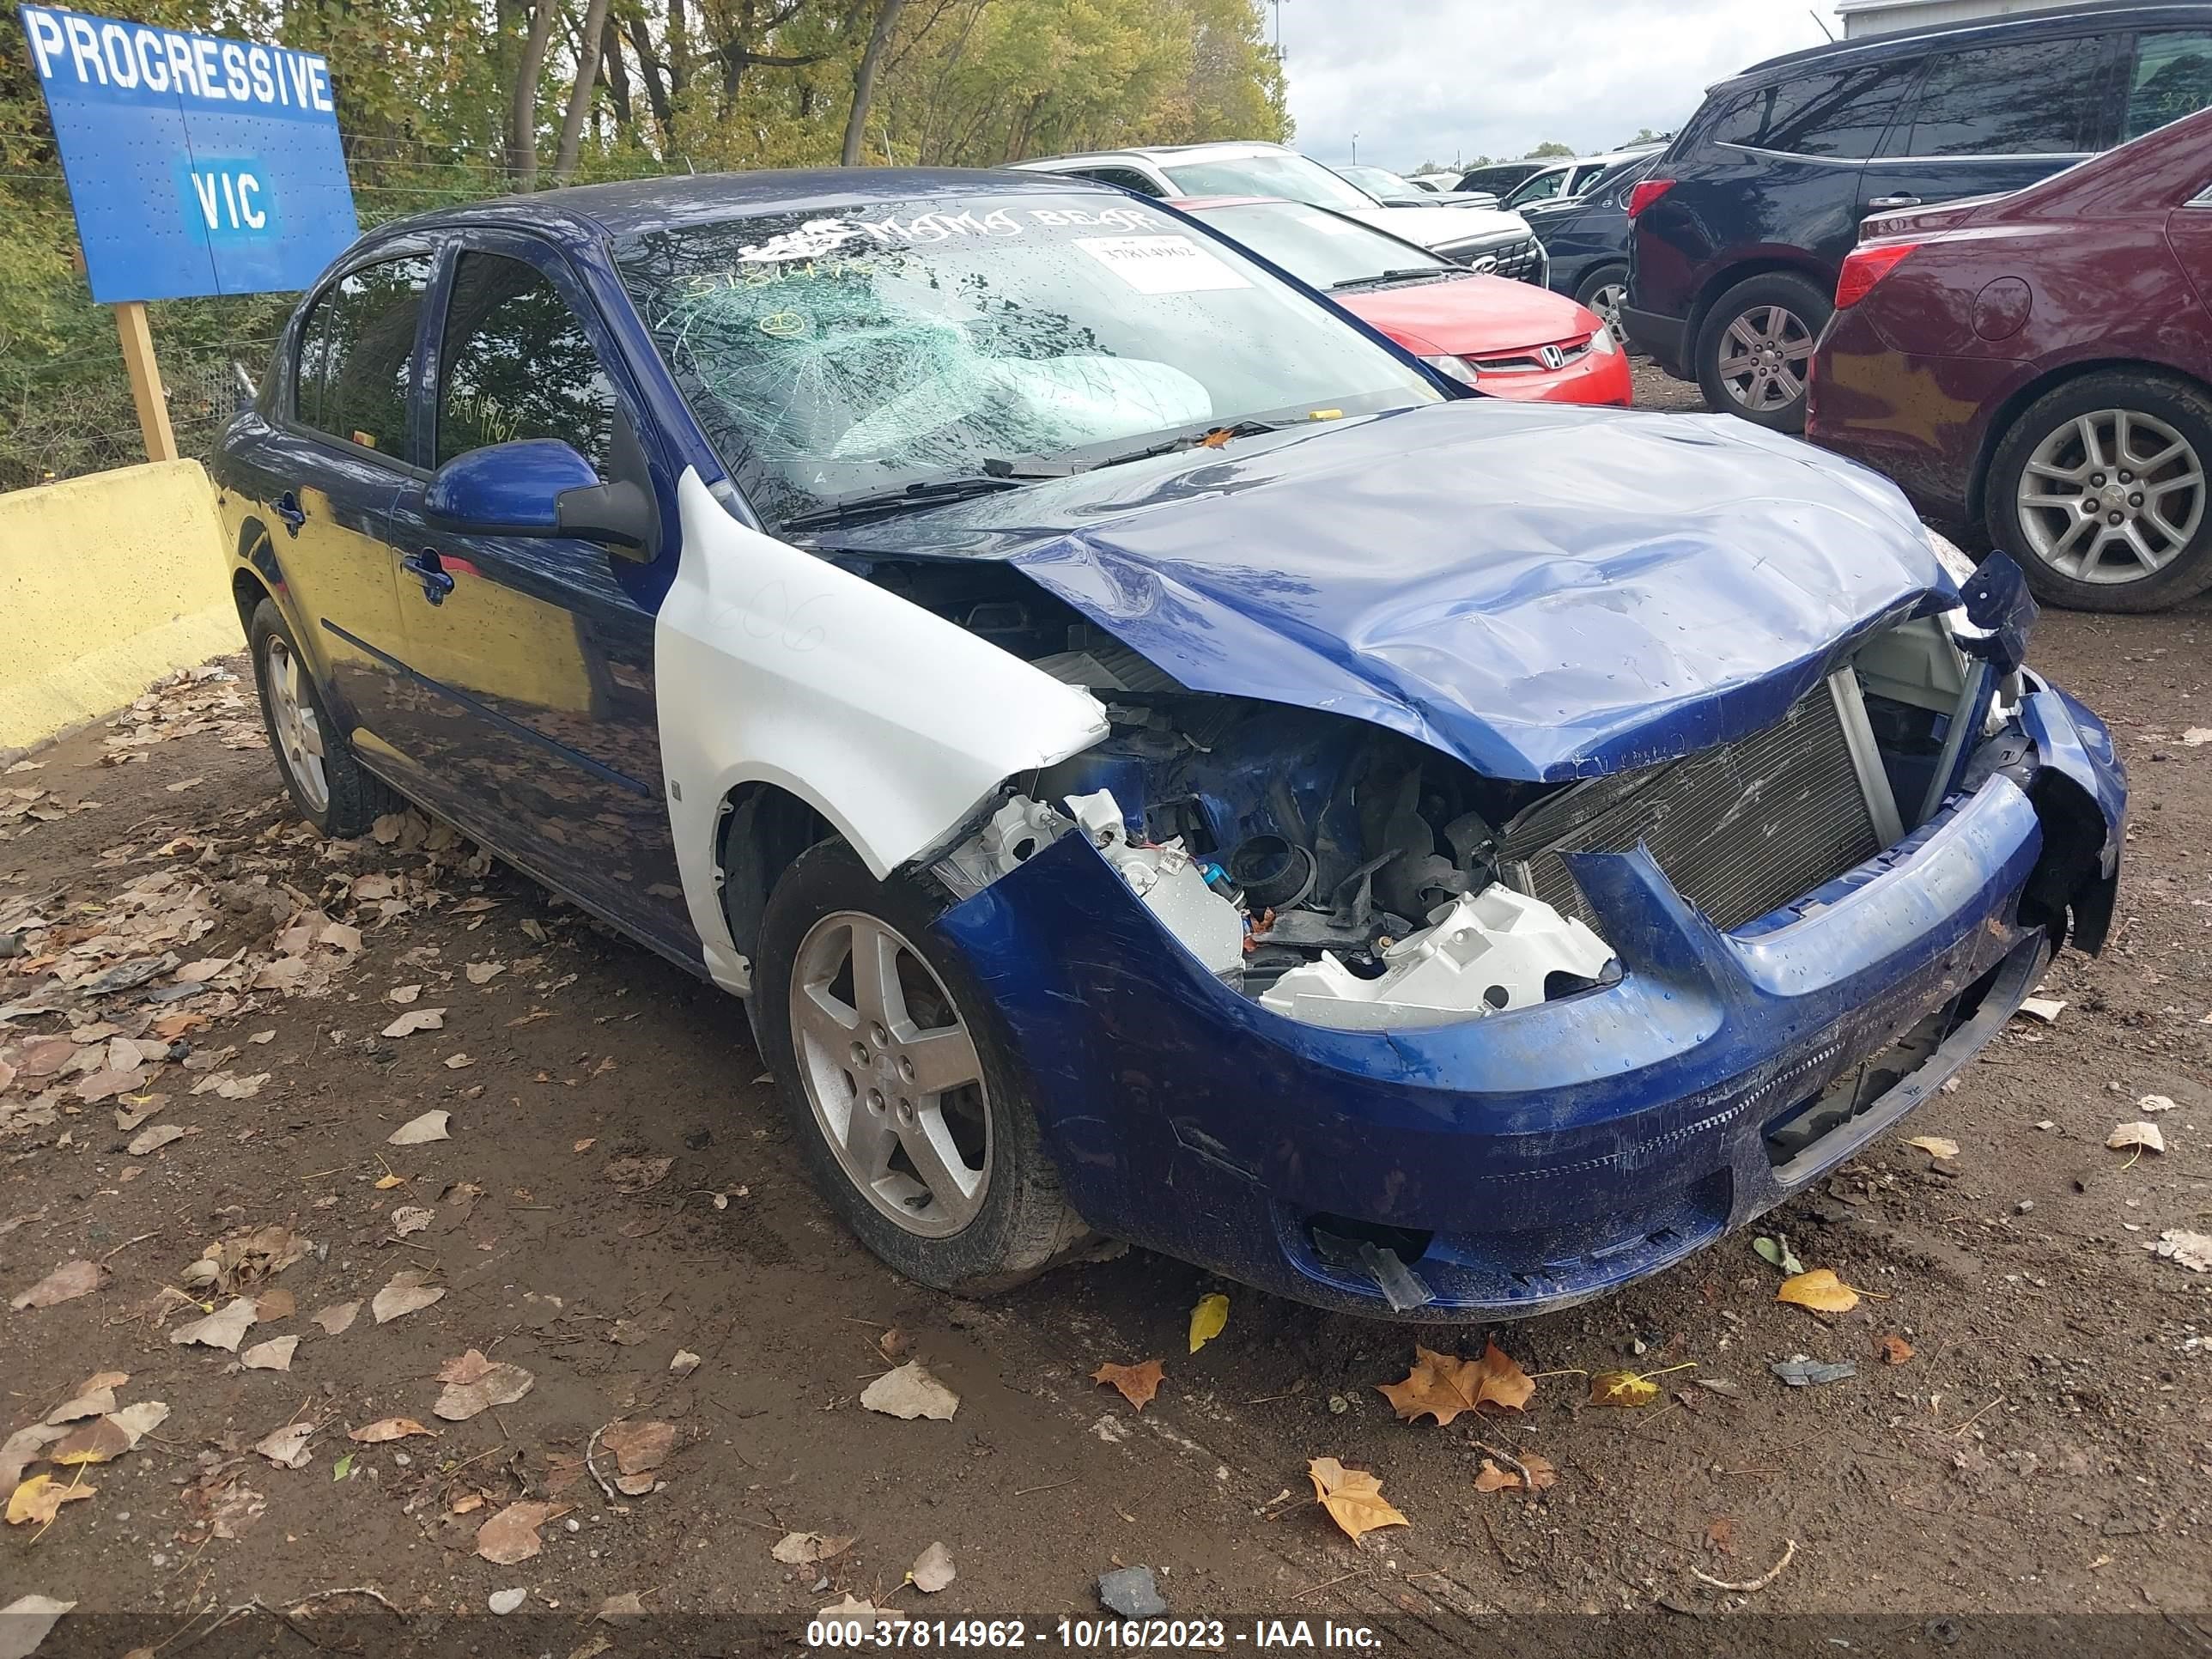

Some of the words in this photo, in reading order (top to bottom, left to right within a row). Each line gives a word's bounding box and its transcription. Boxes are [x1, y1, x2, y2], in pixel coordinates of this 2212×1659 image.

[25, 10, 333, 112] PROGRESSIVE
[191, 173, 266, 229] VIC
[859, 207, 1027, 243] MAMA
